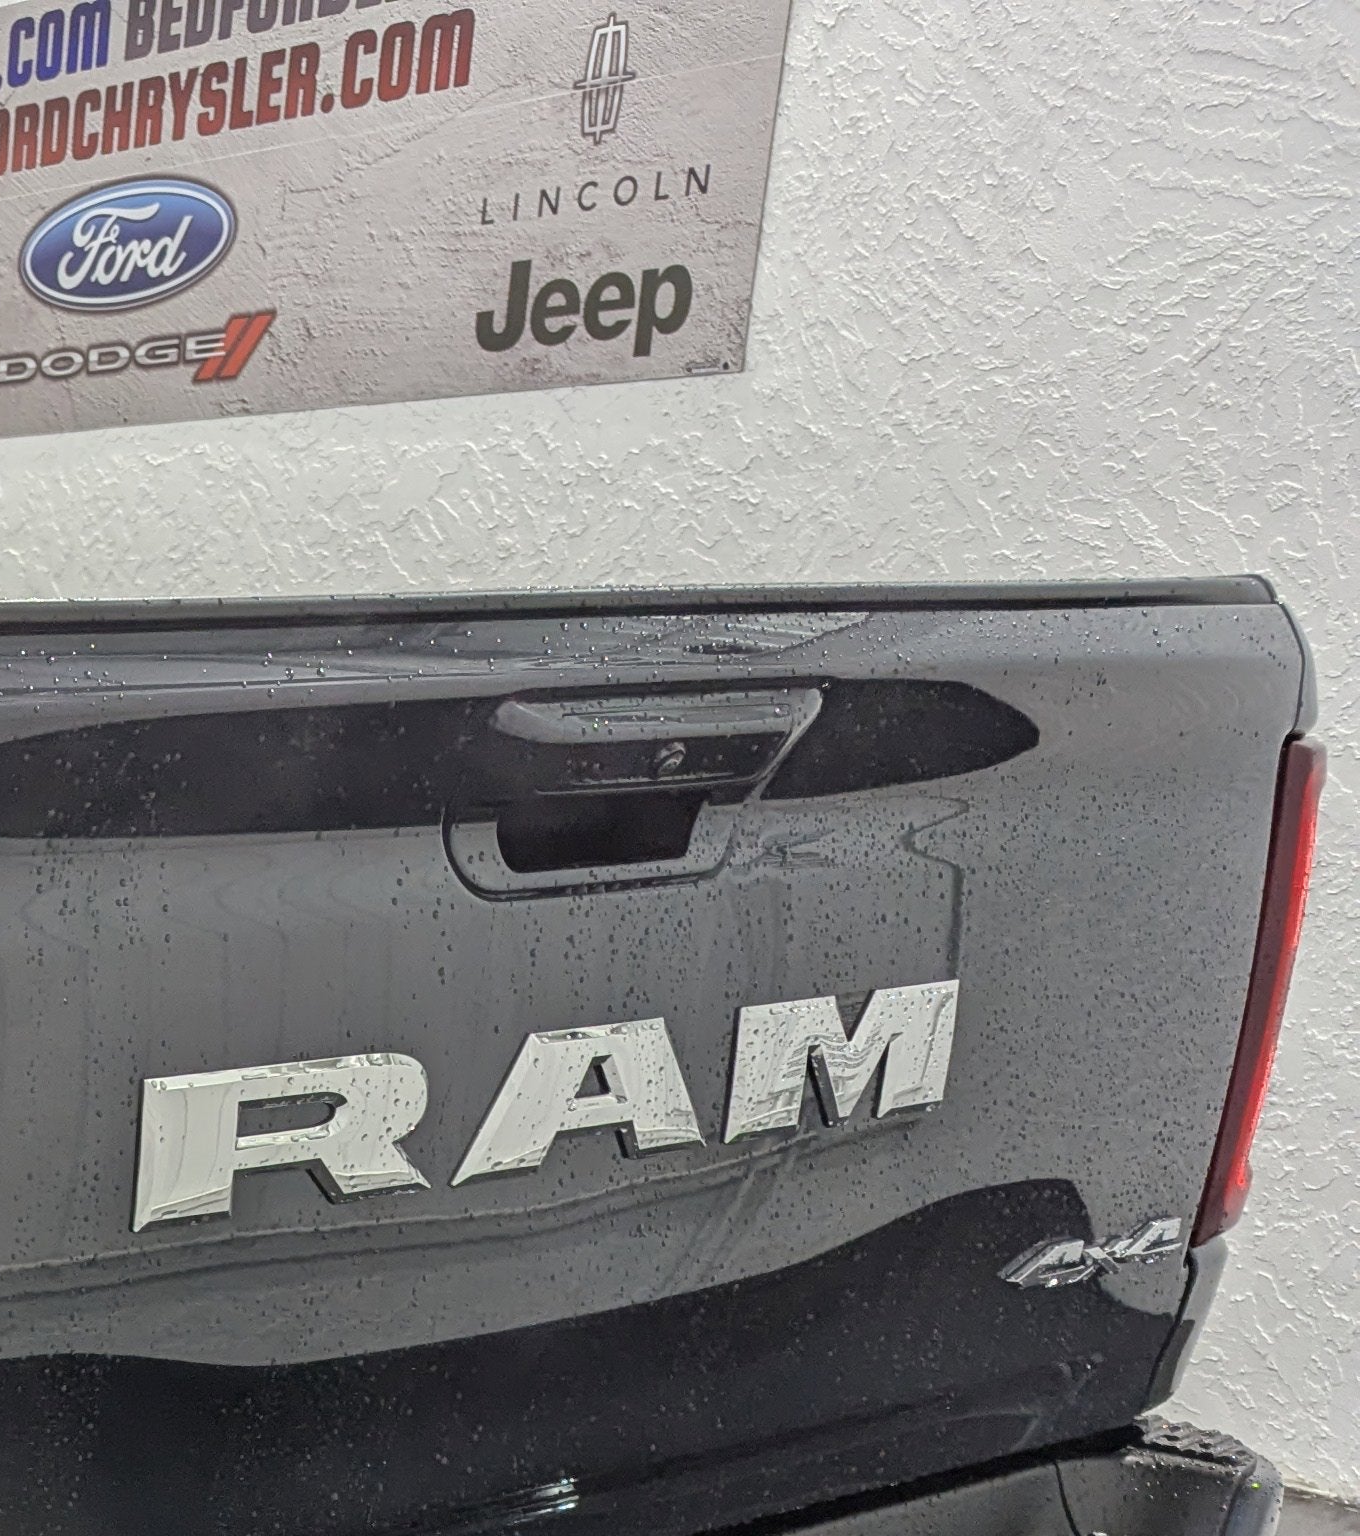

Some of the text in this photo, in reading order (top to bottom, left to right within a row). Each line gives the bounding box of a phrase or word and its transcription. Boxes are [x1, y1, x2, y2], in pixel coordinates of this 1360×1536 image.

[480, 164, 712, 226] LINCOLN
[57, 202, 190, 290] Ford
[475, 259, 693, 358] Jeep
[131, 979, 960, 1234] RAM
